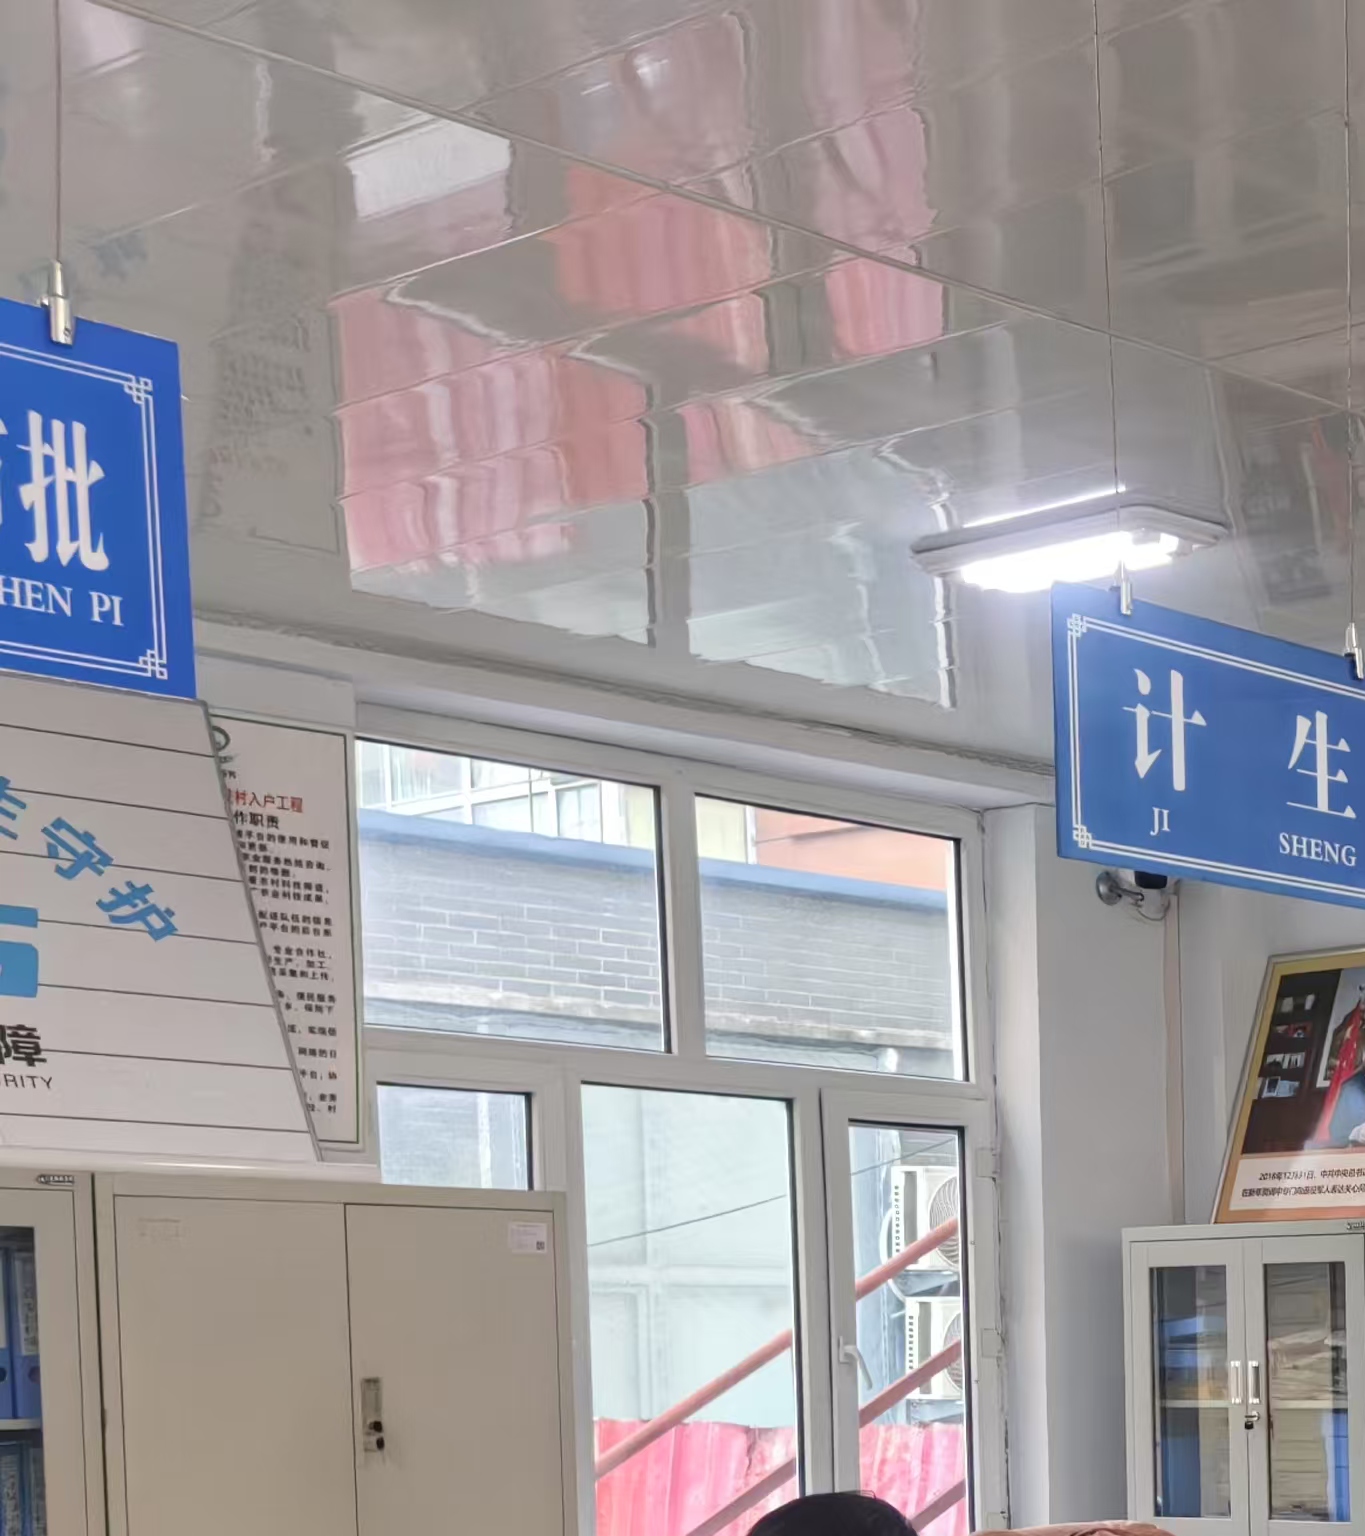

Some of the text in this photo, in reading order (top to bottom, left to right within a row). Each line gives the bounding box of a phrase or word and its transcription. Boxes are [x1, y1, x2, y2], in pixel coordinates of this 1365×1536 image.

[0, 409, 110, 571] 批
[89, 590, 124, 627] PI
[1122, 668, 1356, 819] 计生
[1150, 806, 1357, 867] JI SHENG
